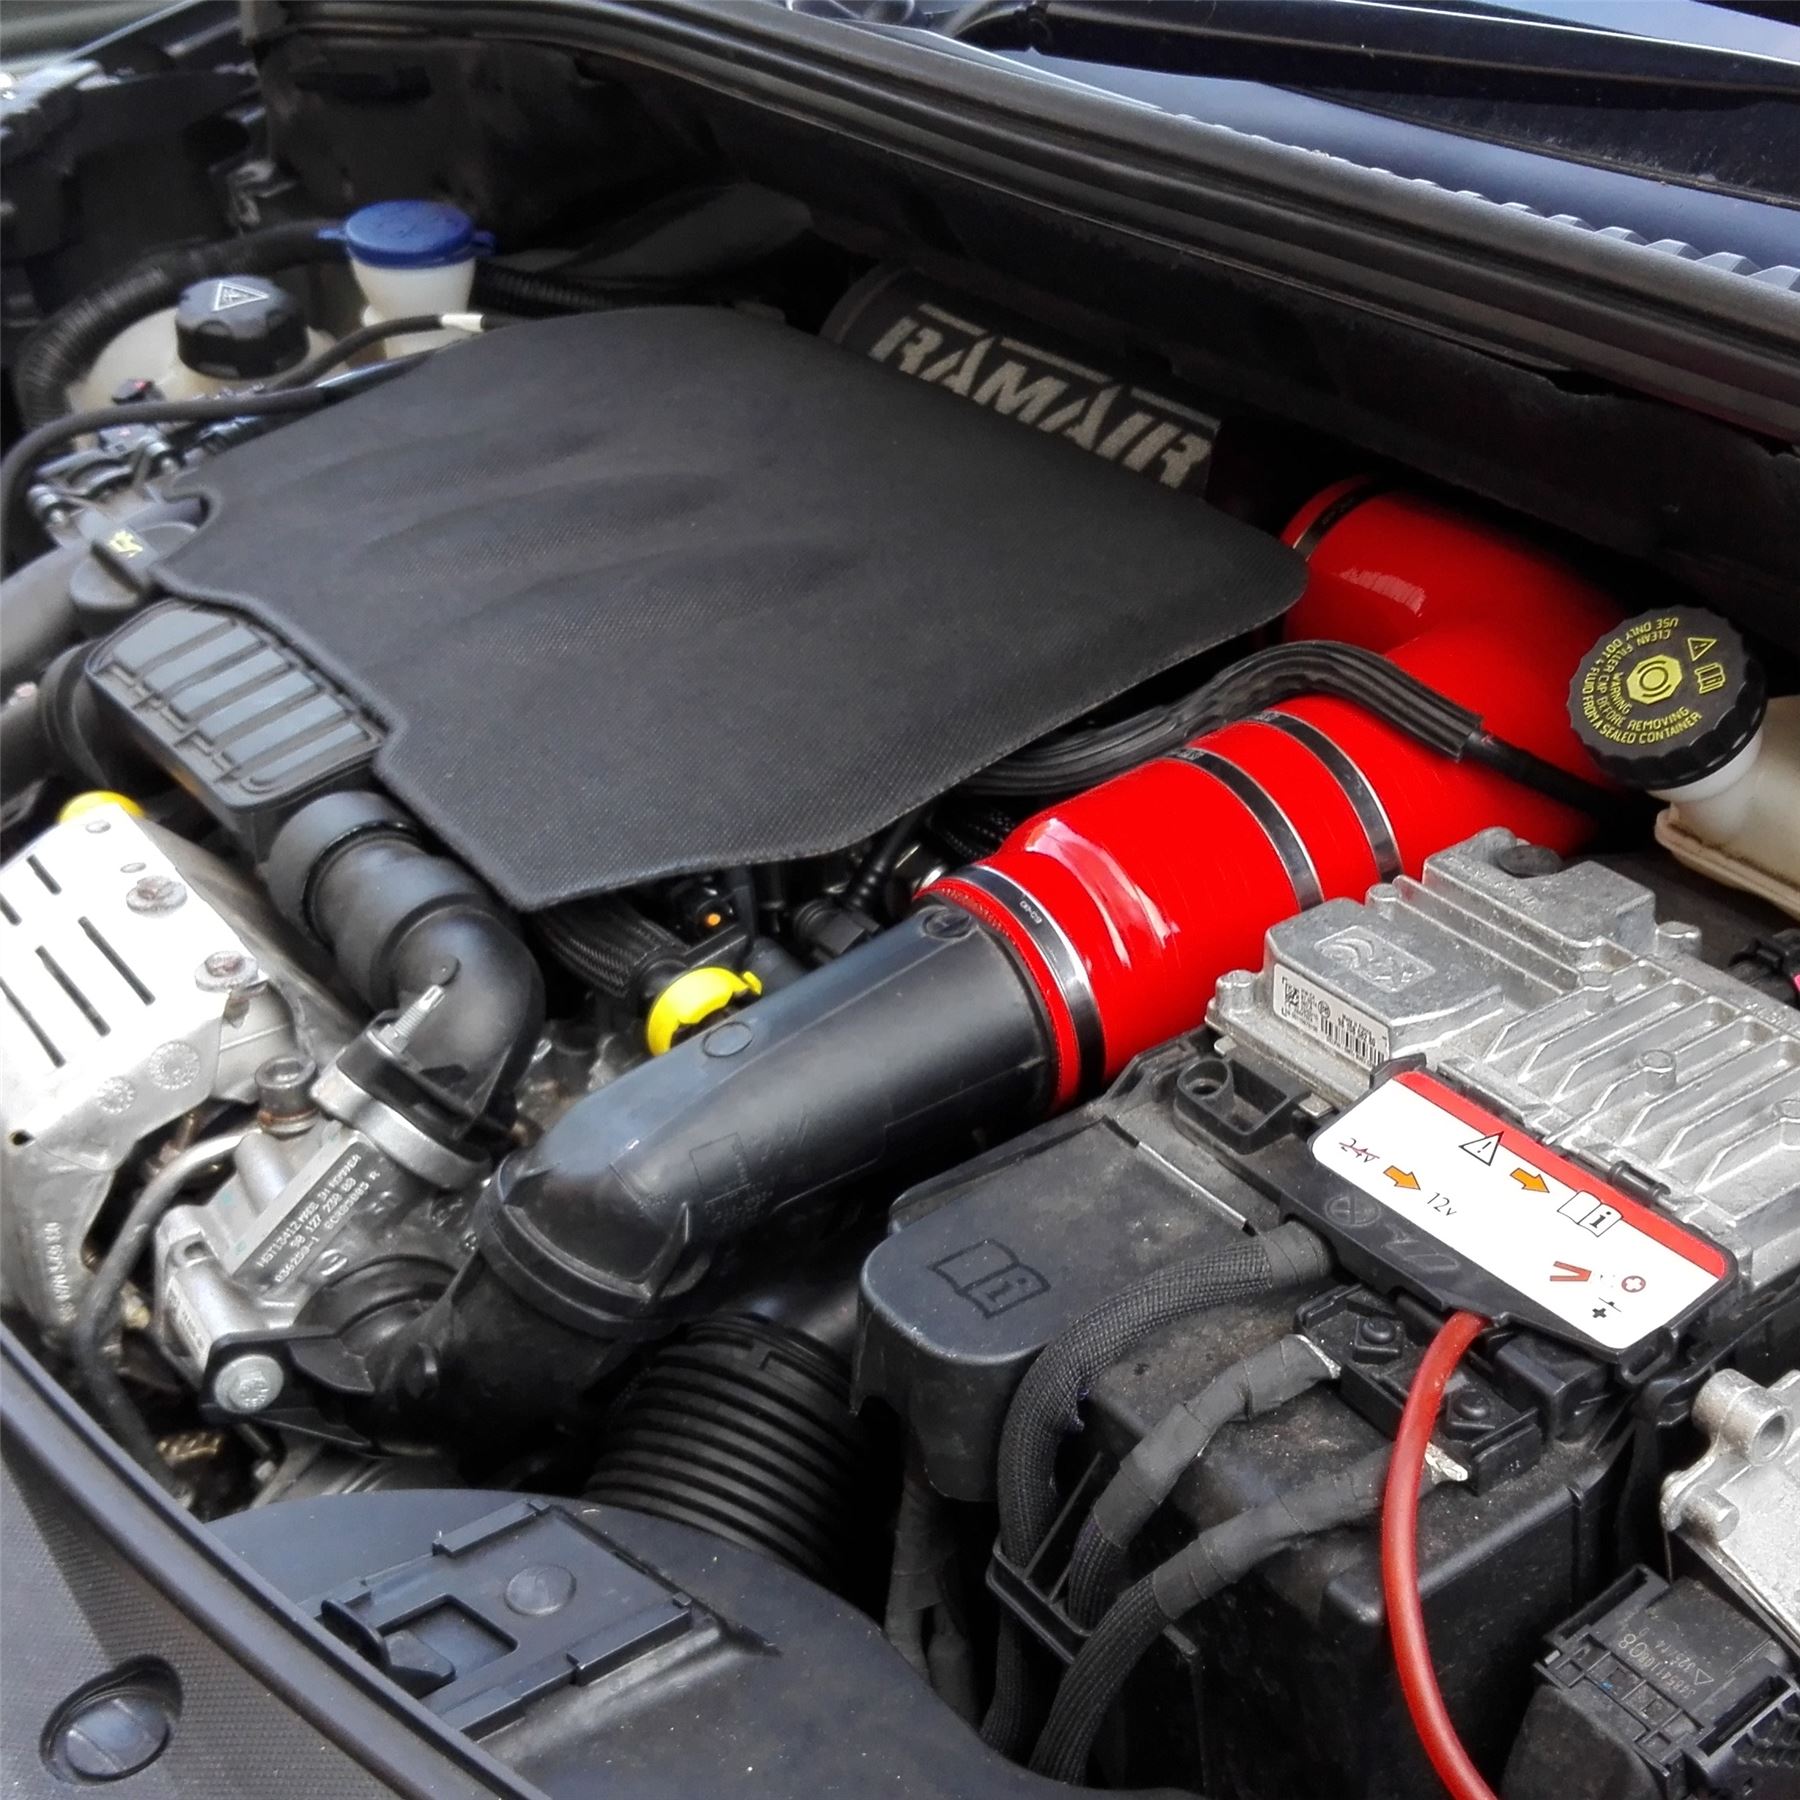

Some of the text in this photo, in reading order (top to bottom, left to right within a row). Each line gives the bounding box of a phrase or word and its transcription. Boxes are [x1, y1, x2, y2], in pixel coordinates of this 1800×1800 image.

[868, 314, 1213, 489] RAMAIR
[1625, 621, 1651, 641] ONLY
[1656, 617, 1679, 628] USE
[1602, 638, 1623, 659] DOT
[1582, 667, 1600, 694] FLUID
[1596, 629, 1692, 731] CLEAN FILLER CAP BEFORE REMOVING
[1610, 671, 1633, 715] WARNING
[1583, 695, 1600, 722] FROM
[1599, 724, 1637, 744] SEALED
[1639, 711, 1703, 744] CONTAINER
